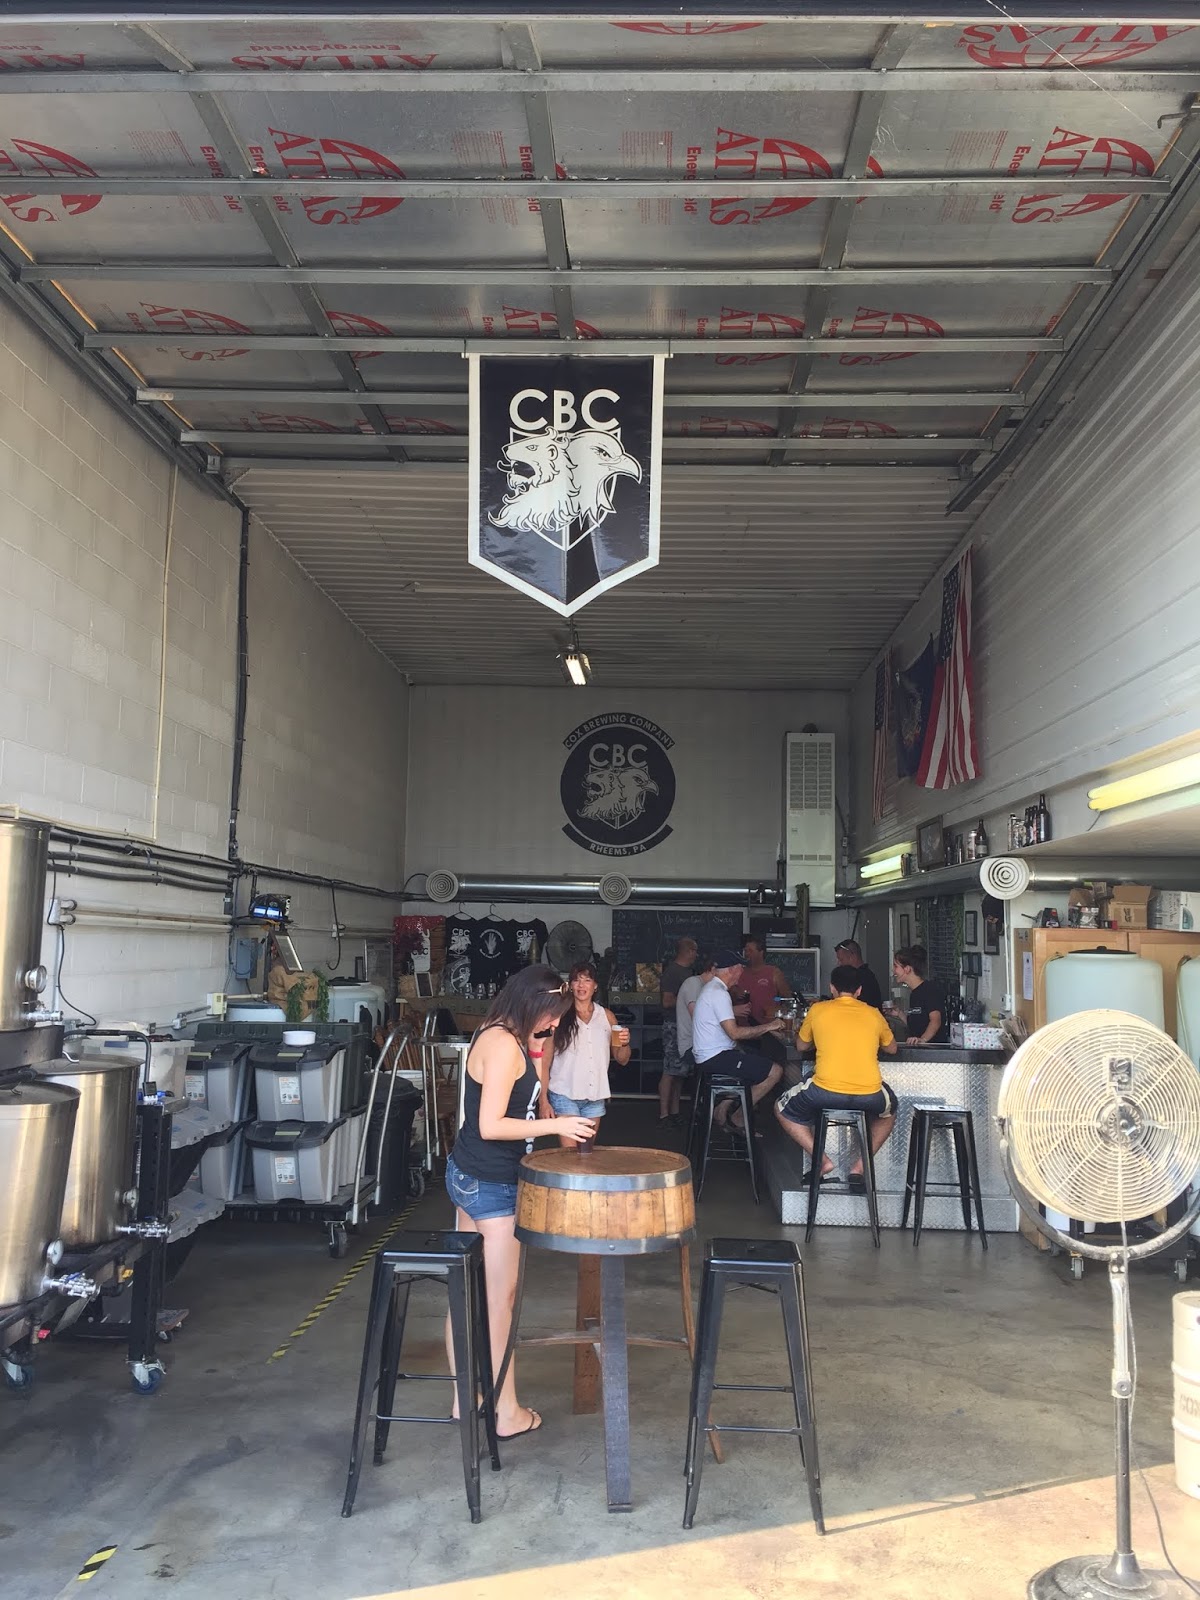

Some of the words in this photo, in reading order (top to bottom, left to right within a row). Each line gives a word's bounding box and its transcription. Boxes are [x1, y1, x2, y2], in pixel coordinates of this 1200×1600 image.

[509, 388, 621, 431] CBC
[565, 729, 583, 748] COX
[583, 714, 627, 732] BREWING
[629, 716, 674, 748] COMPANY
[589, 743, 648, 768] CBC
[633, 844, 647, 853] PA
[452, 927, 470, 936] CBC
[516, 929, 535, 937] CBC
